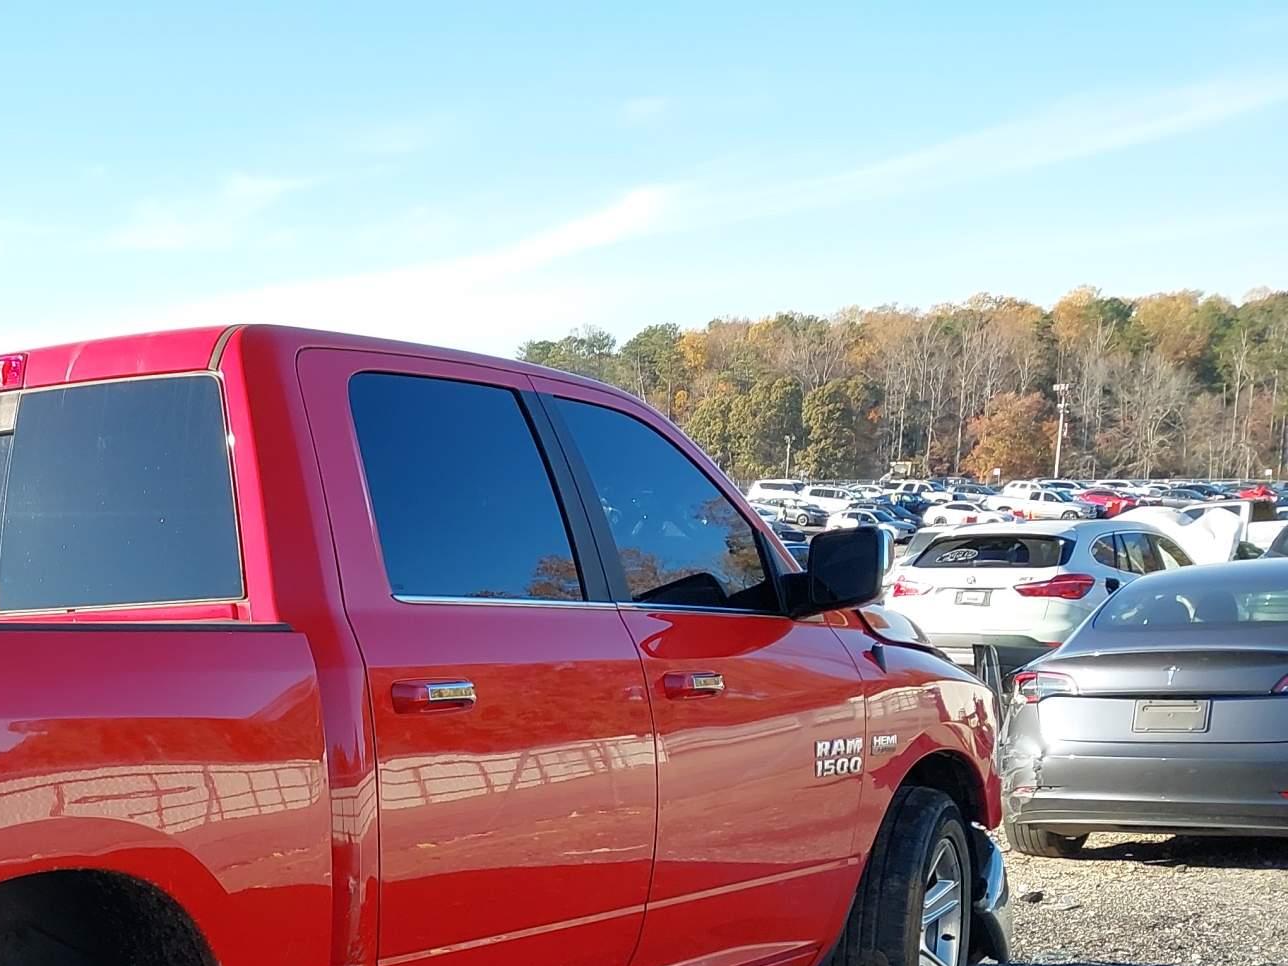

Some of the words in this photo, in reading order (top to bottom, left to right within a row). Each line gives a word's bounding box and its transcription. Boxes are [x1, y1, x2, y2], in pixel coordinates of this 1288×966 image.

[816, 737, 863, 757] RAM
[873, 735, 897, 746] HEMI
[815, 756, 863, 777] 1500
